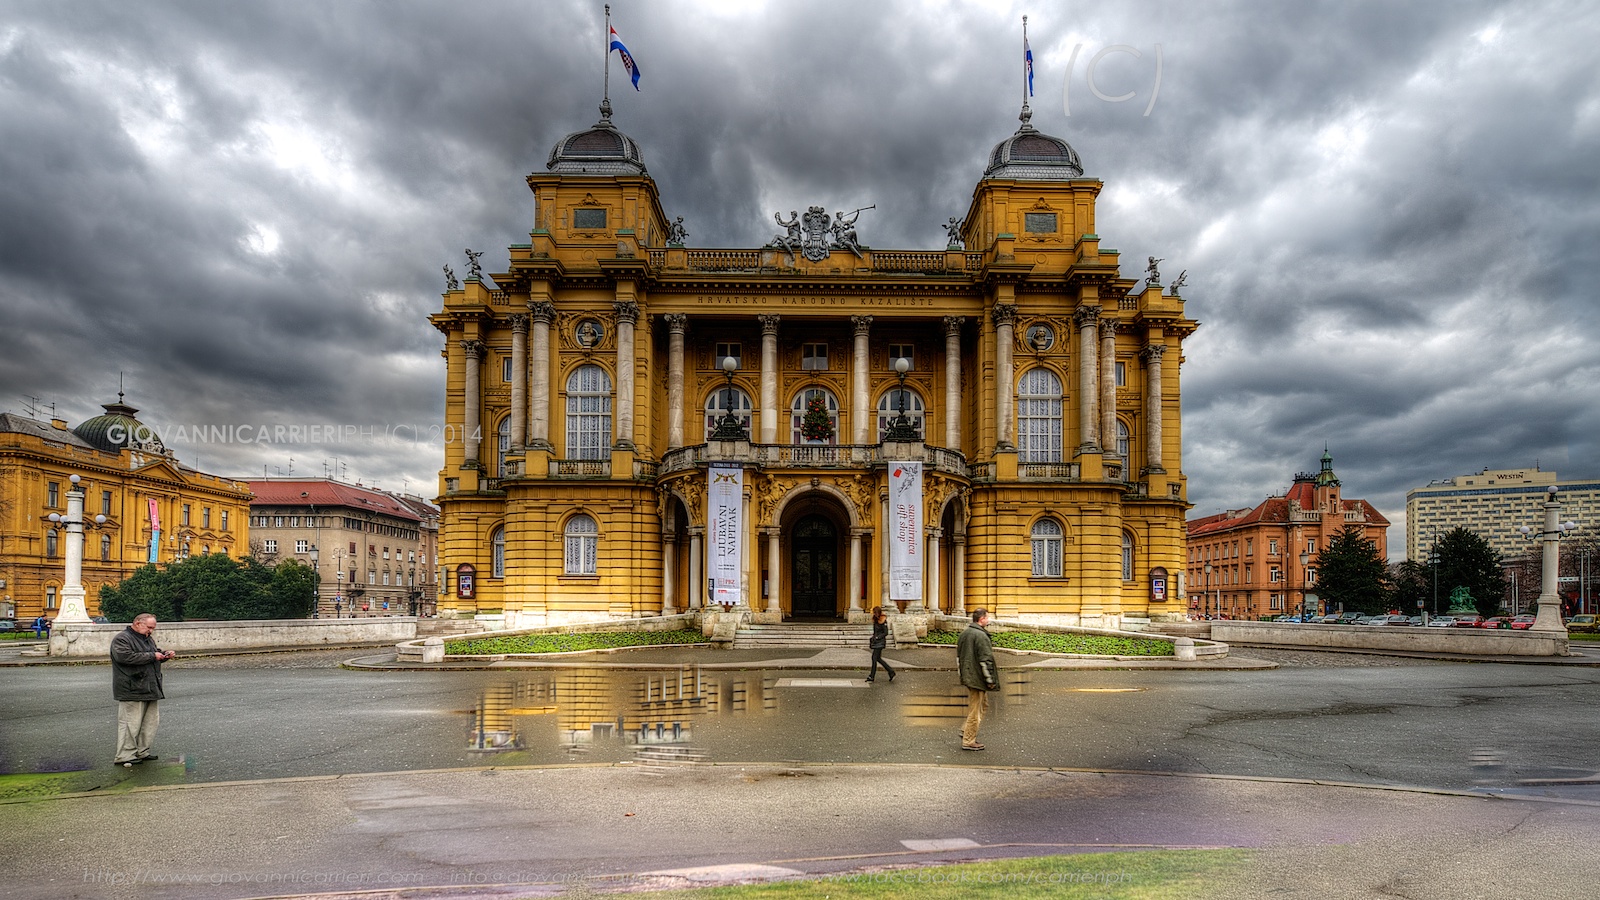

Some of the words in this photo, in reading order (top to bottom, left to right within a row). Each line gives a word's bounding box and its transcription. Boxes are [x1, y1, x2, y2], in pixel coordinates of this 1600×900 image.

[697, 296, 768, 304] HRVATSKO
[782, 297, 846, 305] NARODNO
[860, 297, 934, 306] KAZALIŠTE
[897, 504, 908, 520] gift
[908, 504, 917, 555] suvenirnica
[718, 504, 727, 557] LJUBAVNI
[727, 507, 737, 556] NAPITAK
[897, 521, 908, 543] shop
